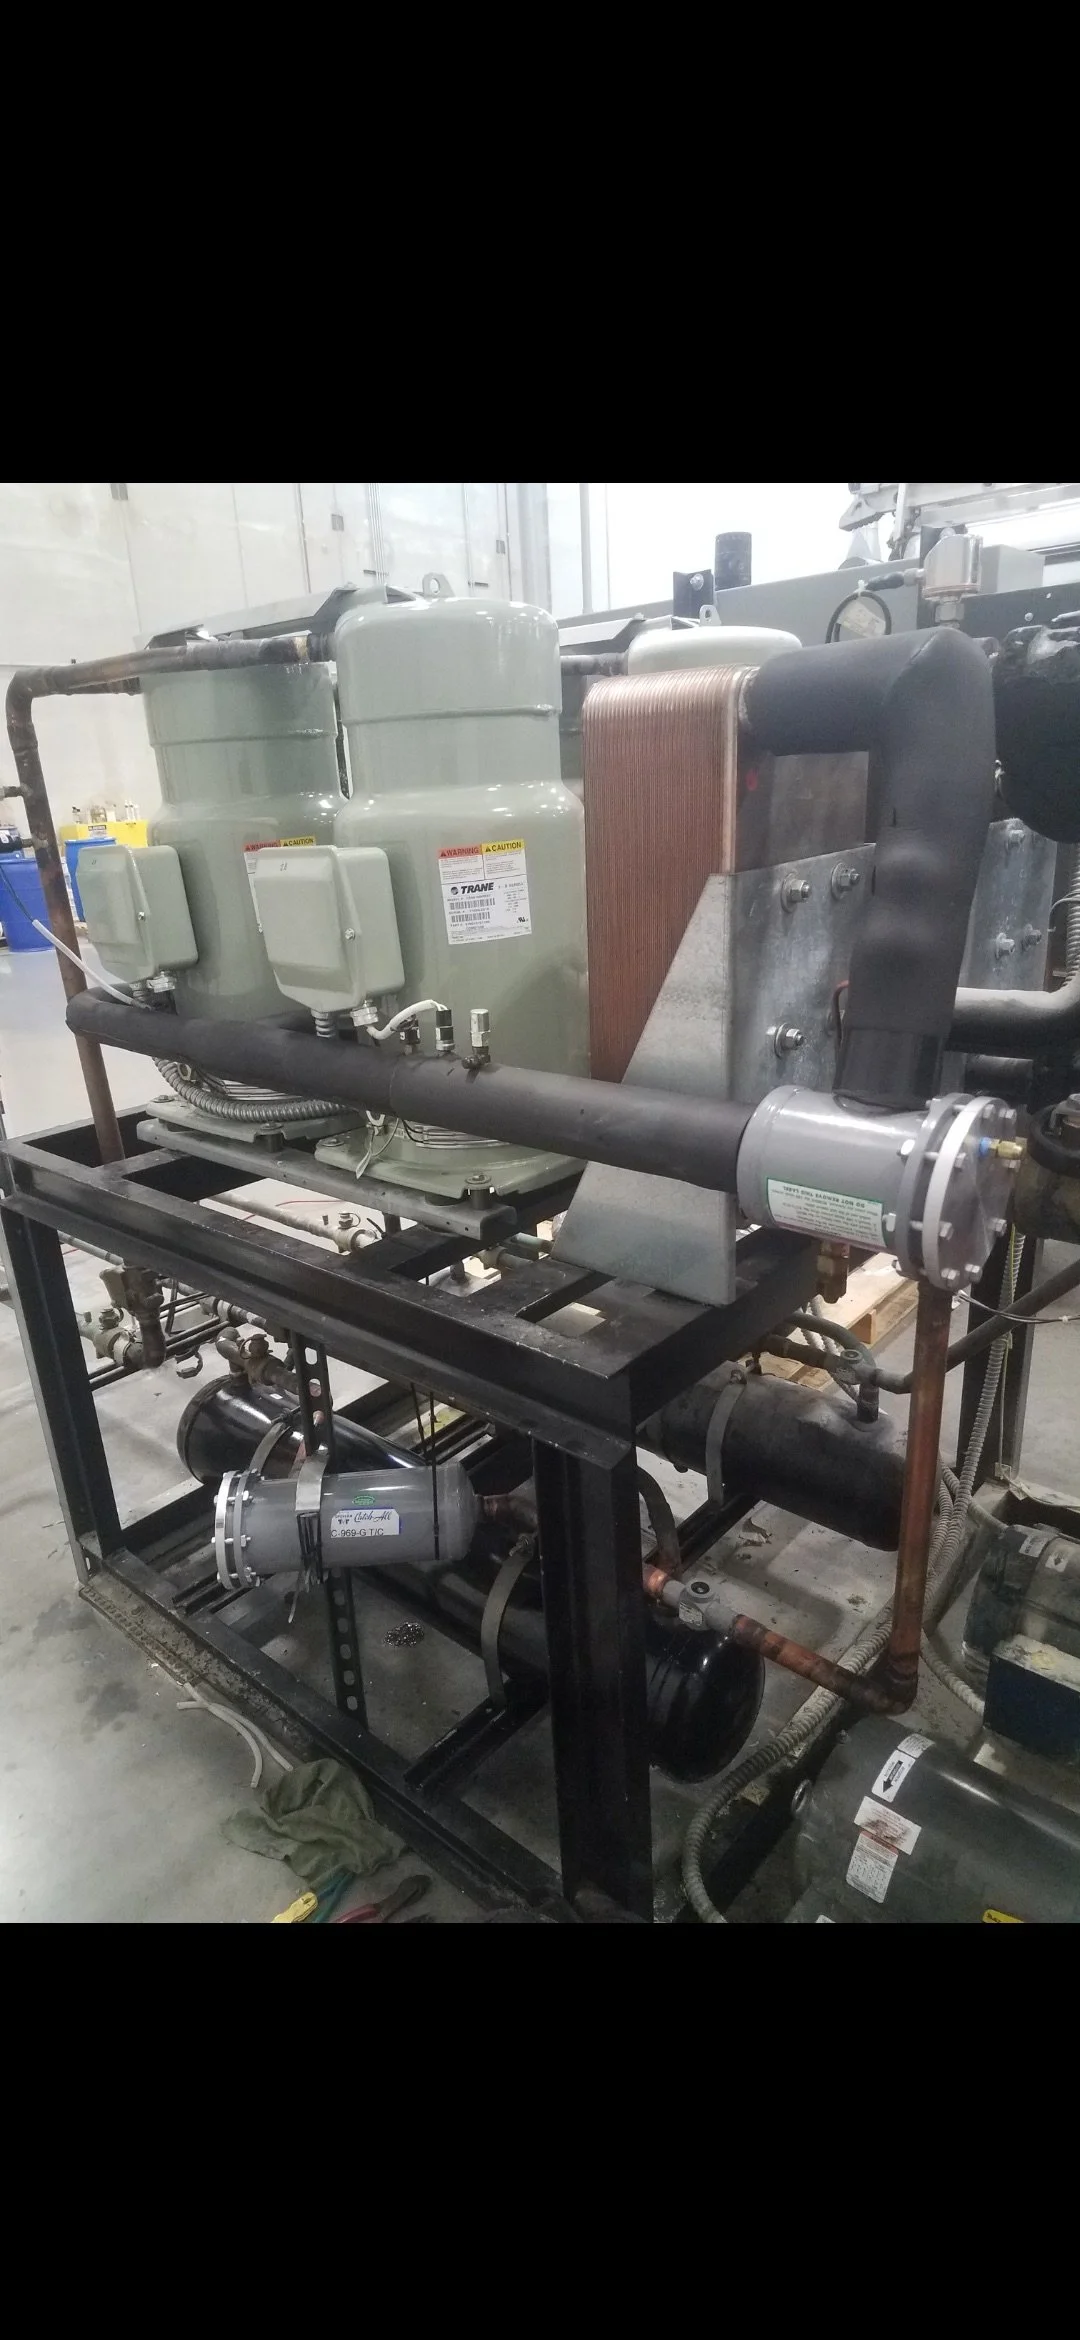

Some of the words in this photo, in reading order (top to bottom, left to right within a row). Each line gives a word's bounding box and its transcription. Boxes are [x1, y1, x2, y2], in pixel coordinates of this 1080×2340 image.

[288, 838, 314, 846] CAUTION
[491, 841, 522, 852] CAUTION
[446, 847, 479, 856] WARNING
[461, 882, 494, 895] TRANE
[331, 1528, 367, 1537] C-969-G
[369, 1528, 384, 1536] T/C
